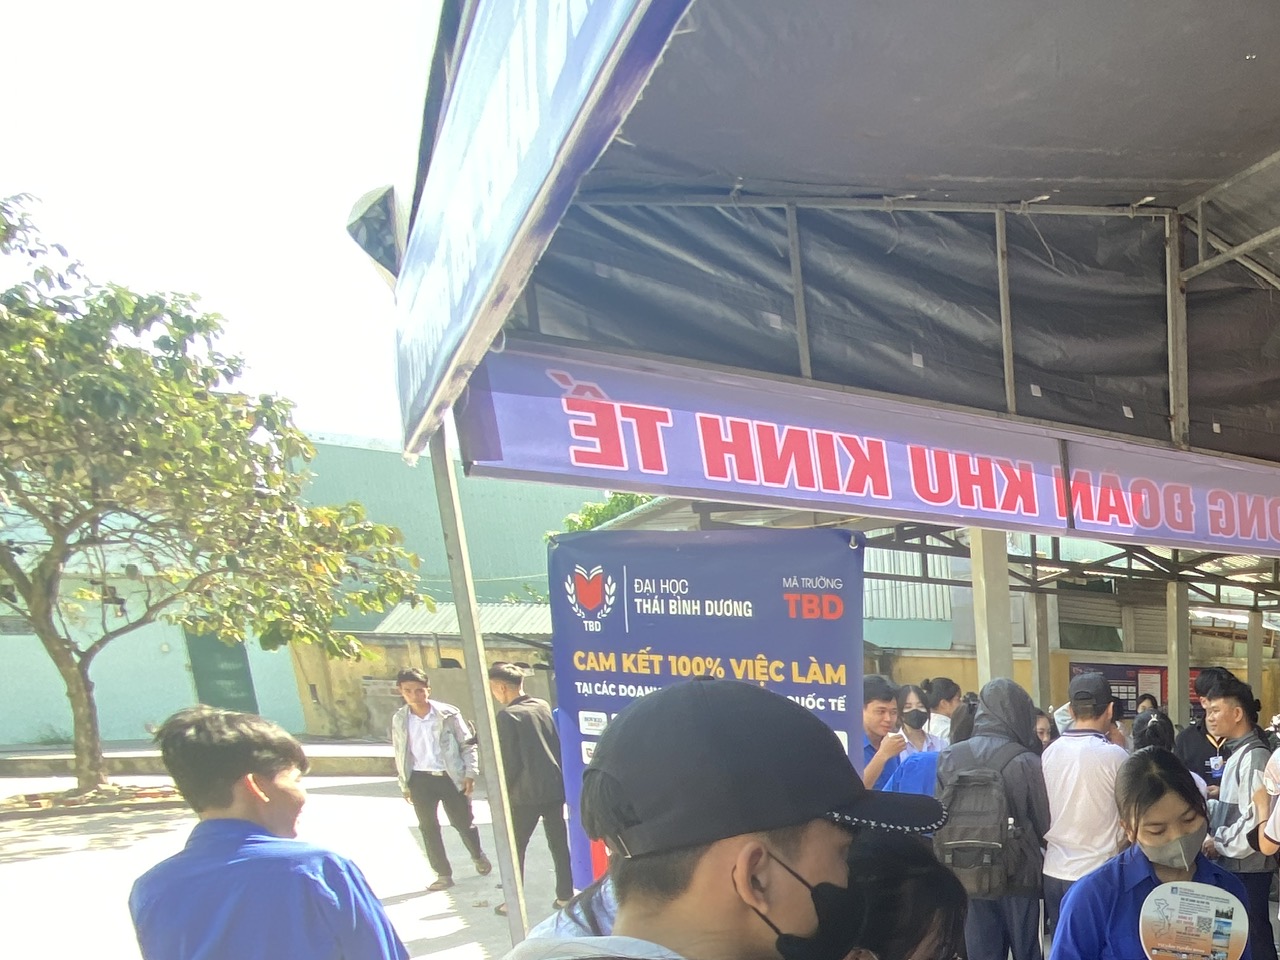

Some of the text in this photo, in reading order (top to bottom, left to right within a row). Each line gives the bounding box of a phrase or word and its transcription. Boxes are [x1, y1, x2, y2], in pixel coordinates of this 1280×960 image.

[634, 578, 689, 596] ĐẠI HỌC
[783, 575, 843, 590] MÃ TRƯỜNG
[634, 596, 752, 618] THÁI BÌNH DƯƠNG
[784, 593, 844, 620] TBD
[583, 620, 601, 632] TBD
[573, 647, 846, 687] CAM KẾT 100% VIỆC LÀM
[575, 681, 592, 696] TẠI
[594, 680, 616, 696] CÁC
[619, 684, 662, 697] DOAN
[828, 695, 846, 711] TẾ
